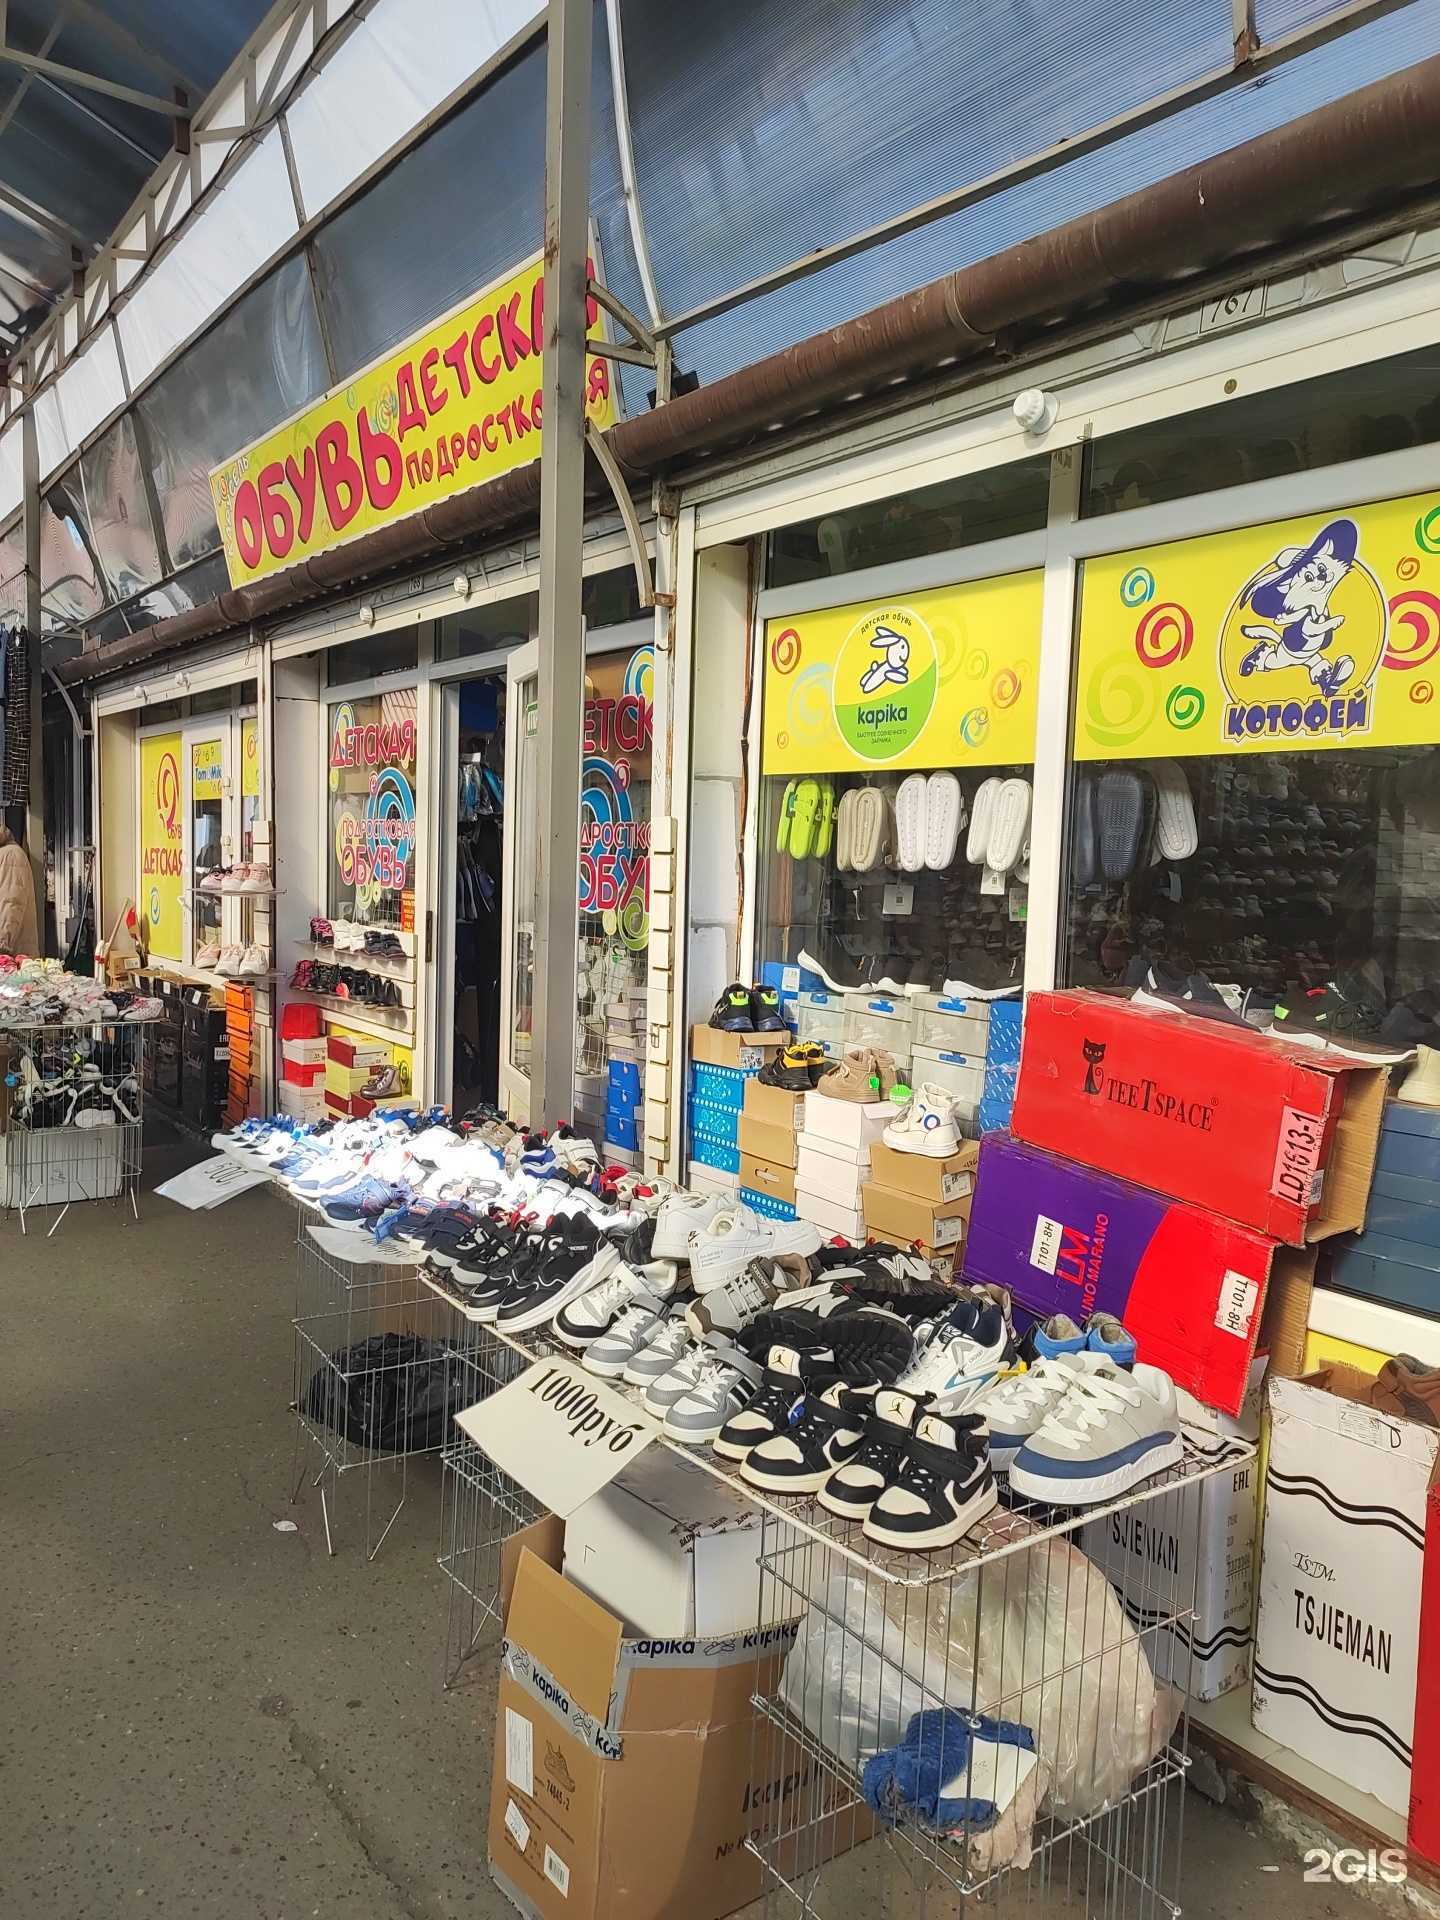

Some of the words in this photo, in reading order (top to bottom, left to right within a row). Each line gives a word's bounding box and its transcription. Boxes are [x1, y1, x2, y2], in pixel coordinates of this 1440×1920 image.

[234, 406, 403, 570] ОБУВЬ
[857, 703, 908, 730] kapika
[1228, 689, 1369, 737] КОТОФЕЙ
[330, 719, 414, 768] ДЕТСКАЯ
[342, 819, 415, 840] ПОДРОСТКОВАЯ
[341, 844, 406, 890] ОБУВЬ
[1037, 1221, 1054, 1266] T101-8H
[1226, 1280, 1248, 1331] T101-8H
[527, 1368, 646, 1452] 1000руб
[1294, 1588, 1391, 1674] TSJIEMAN
[532, 1665, 569, 1715] kapika
